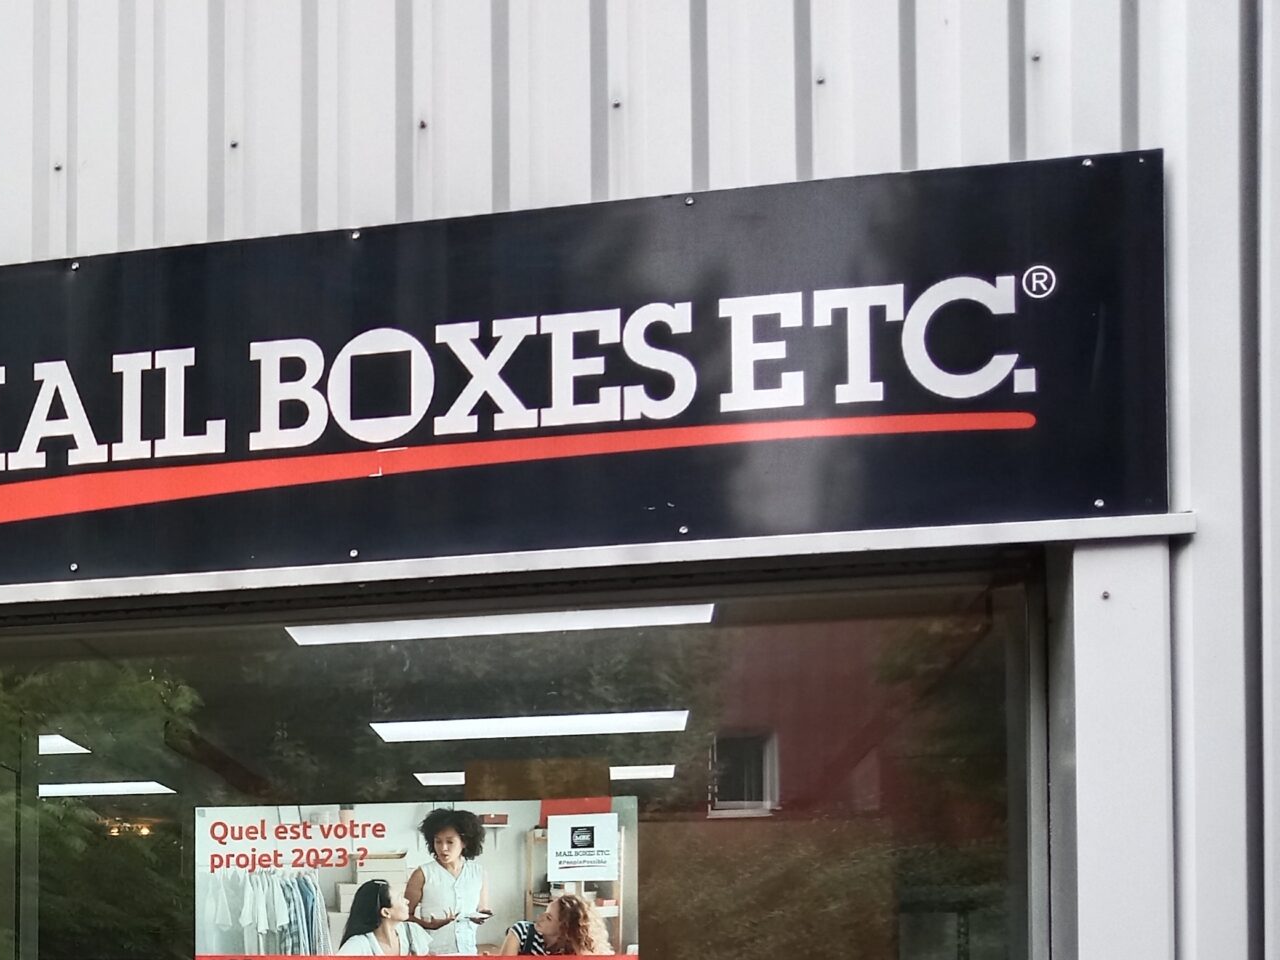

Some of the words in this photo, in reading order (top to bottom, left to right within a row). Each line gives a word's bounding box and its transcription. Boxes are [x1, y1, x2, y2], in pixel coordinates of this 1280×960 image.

[249, 303, 697, 451] BOXES
[719, 276, 1037, 413] ETC.
[210, 820, 266, 845] Quel
[274, 822, 312, 839] est
[321, 820, 386, 839] votre
[210, 848, 283, 872] projet
[292, 849, 348, 868] 2023
[357, 847, 368, 866] ?
